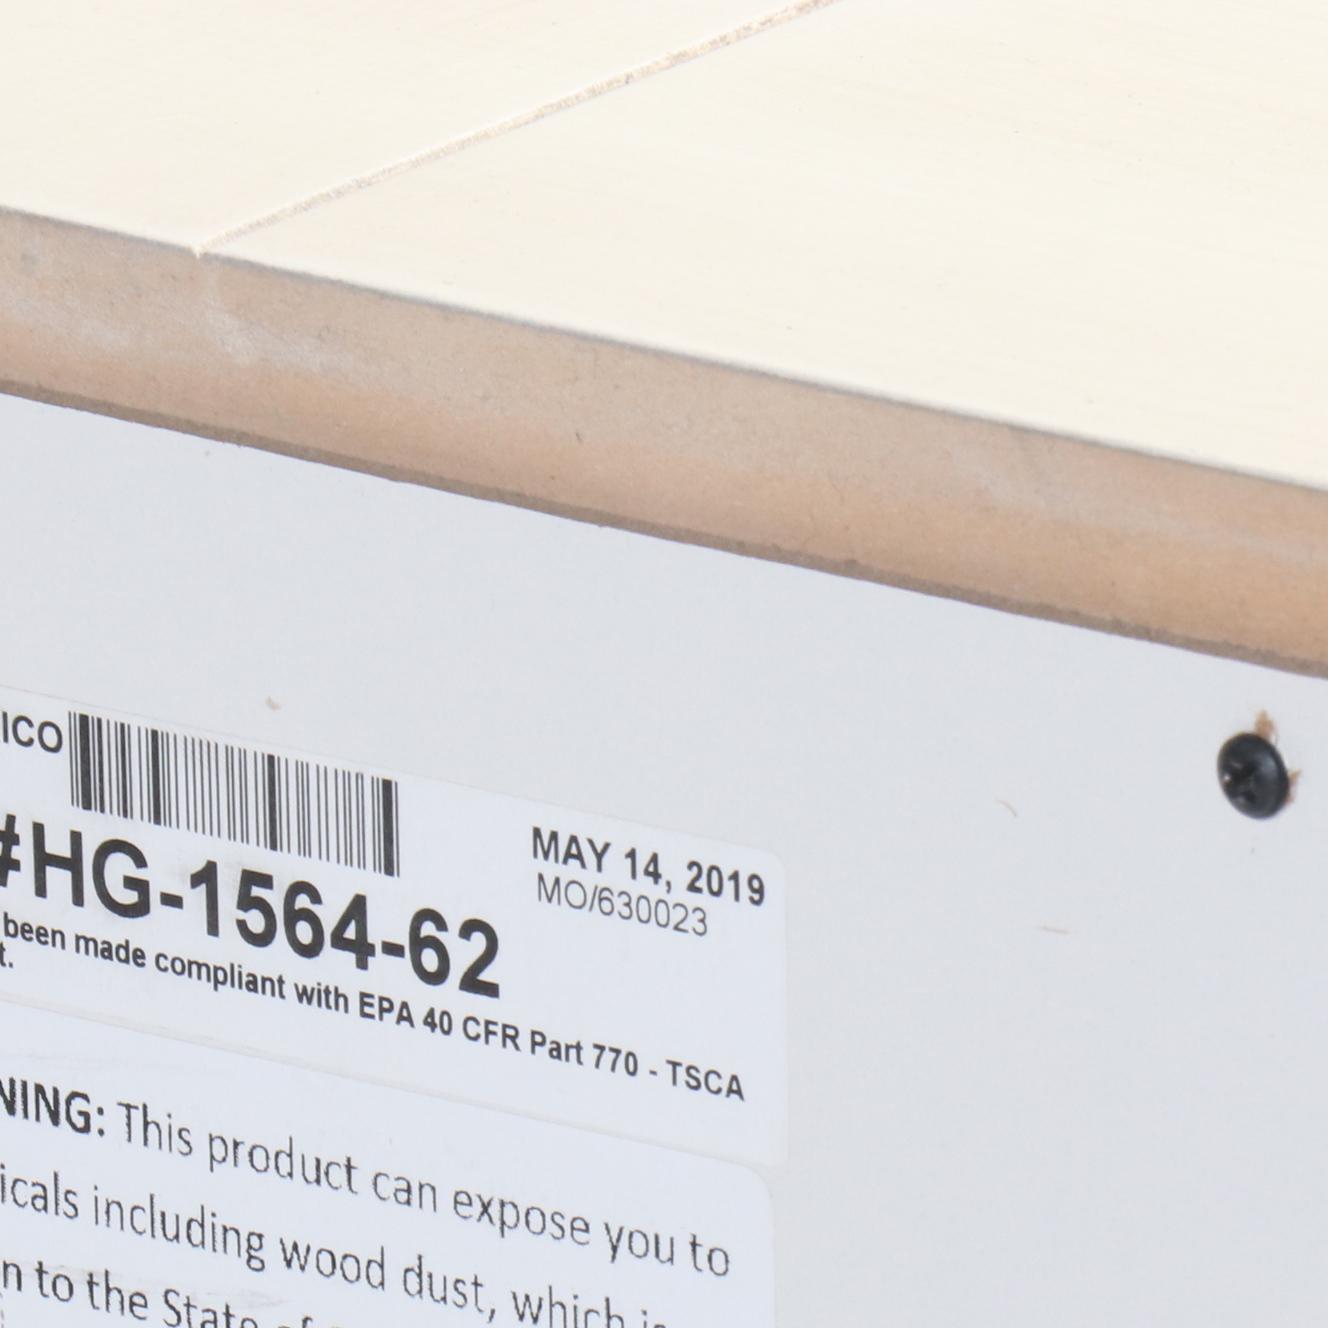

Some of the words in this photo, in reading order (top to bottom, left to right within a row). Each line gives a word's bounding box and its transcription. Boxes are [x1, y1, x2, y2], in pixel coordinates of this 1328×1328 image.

[532, 827, 610, 873] MAY
[625, 847, 672, 893] 14,
[686, 861, 765, 906] 2019
[537, 872, 708, 937] MO/630023
[3, 911, 66, 950] been
[75, 928, 146, 968] made
[155, 952, 285, 1000] compliant
[294, 979, 349, 1014] with
[359, 992, 414, 1028] EPA
[422, 1007, 452, 1035] 40
[463, 1016, 521, 1051] CFR
[530, 1030, 584, 1065] Part
[593, 1044, 638, 1076] 770
[666, 1060, 745, 1102] TSCA
[119, 1102, 193, 1157] This
[209, 1132, 359, 1195] product
[374, 1168, 437, 1211] can
[453, 1189, 591, 1245] expose
[605, 1222, 674, 1265] you
[690, 1233, 730, 1276] to
[37, 1262, 74, 1302] to
[87, 1269, 148, 1321] the
[94, 1185, 266, 1271] including
[280, 1237, 385, 1290] wood
[403, 1254, 495, 1323] dust,
